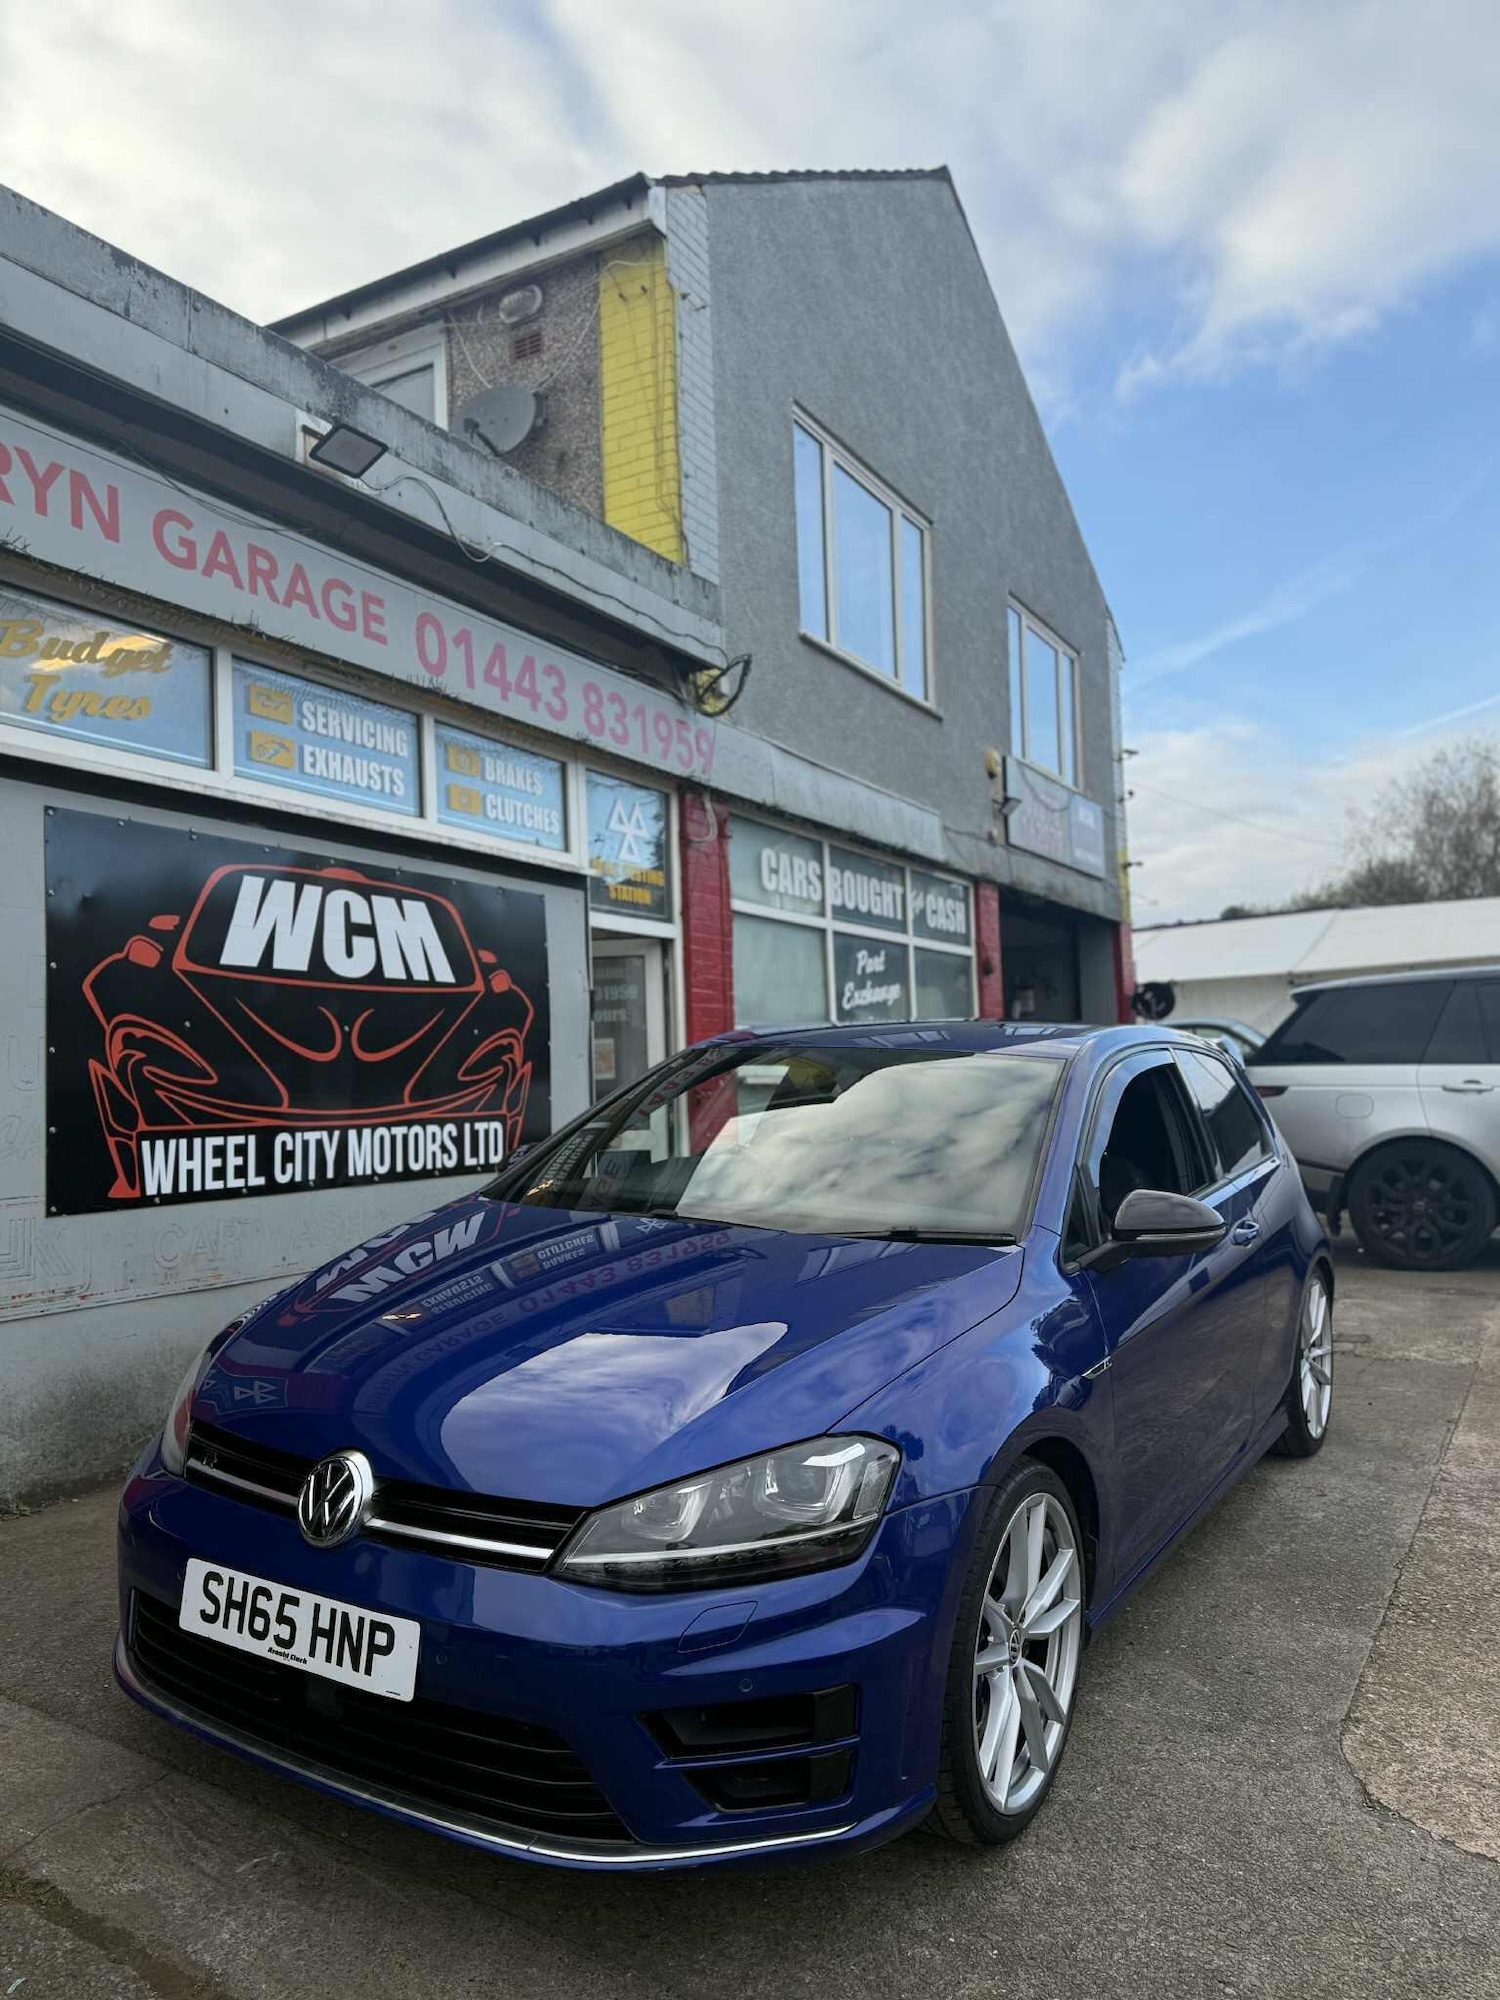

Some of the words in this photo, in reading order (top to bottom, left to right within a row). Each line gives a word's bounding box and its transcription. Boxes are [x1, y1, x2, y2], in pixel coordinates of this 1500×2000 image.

[0, 619, 172, 677] Budget
[152, 508, 388, 645] GARAGE
[415, 611, 568, 720] 01443
[583, 680, 715, 775] 831959
[23, 673, 153, 723] Tyres
[301, 701, 408, 758] SERVICING
[302, 744, 405, 796] EXHAUSTS
[484, 756, 542, 796] BRAKES
[485, 793, 560, 836] CLUTCHES
[760, 847, 823, 902] CARS
[829, 865, 904, 921] BOUGHT
[925, 893, 967, 934] CASH
[219, 874, 456, 984] WCM
[141, 1134, 265, 1197] WHEEL
[273, 1129, 340, 1184] CITY
[347, 1125, 459, 1178] MOTORS
[464, 1120, 504, 1165] LTD
[200, 1571, 300, 1650] SH65
[309, 1602, 395, 1677] HNP
